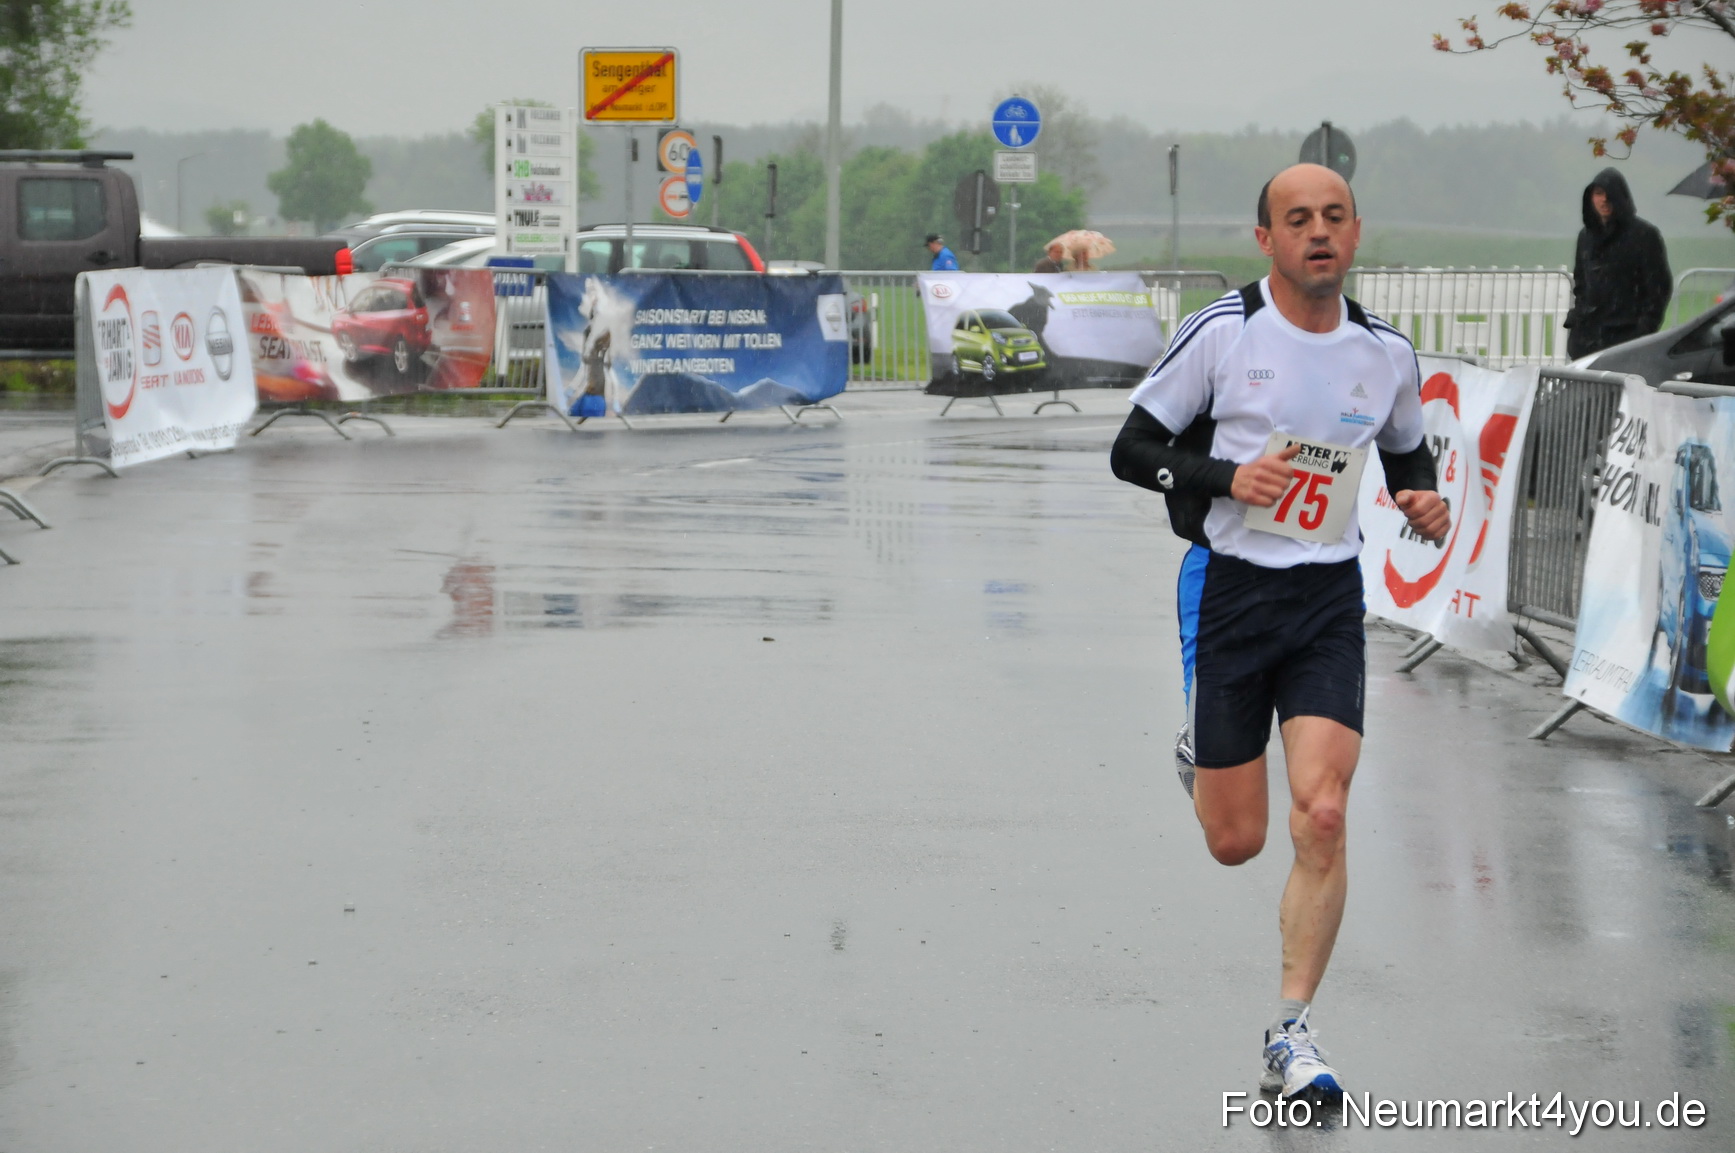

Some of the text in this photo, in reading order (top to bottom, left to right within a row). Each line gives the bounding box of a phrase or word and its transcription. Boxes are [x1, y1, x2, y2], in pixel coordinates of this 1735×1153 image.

[592, 60, 667, 82] Sengenthal
[669, 143, 689, 161] 60
[635, 308, 707, 325] SAISONSTART
[707, 310, 726, 325] BEI
[174, 324, 191, 349] KIA
[630, 333, 663, 349] GANZ
[665, 334, 692, 348] WEIT
[722, 334, 743, 349] MIT
[743, 333, 783, 348] TOLLEN
[629, 358, 736, 374] WINTERANGEBOTEN
[1290, 453, 1329, 469] ERBUNG
[1273, 468, 1334, 531] 75
